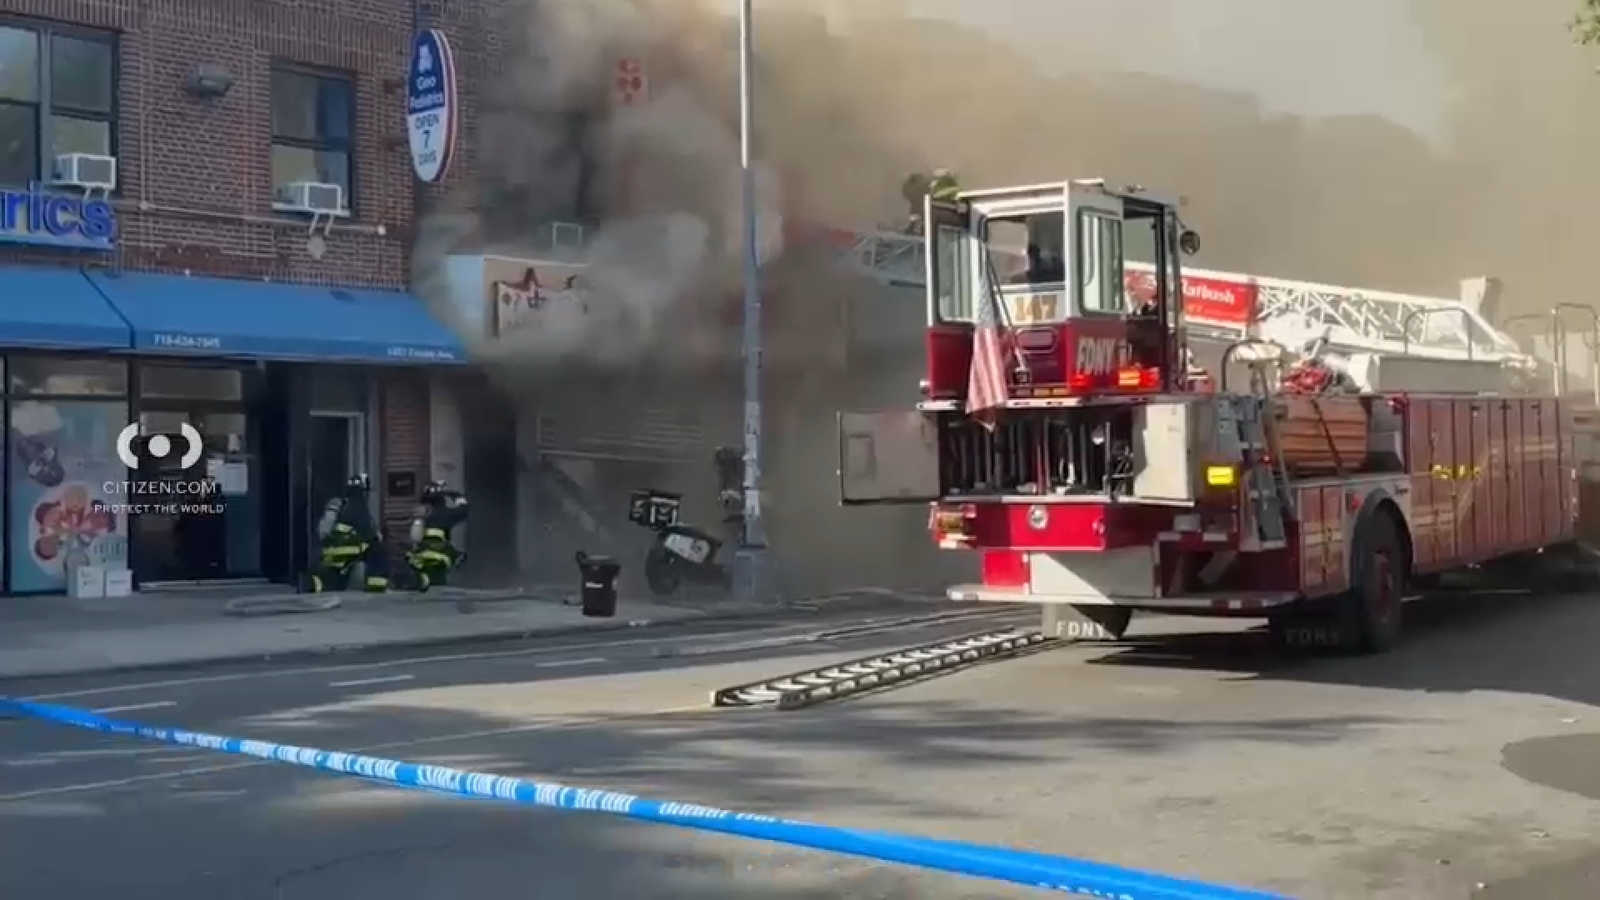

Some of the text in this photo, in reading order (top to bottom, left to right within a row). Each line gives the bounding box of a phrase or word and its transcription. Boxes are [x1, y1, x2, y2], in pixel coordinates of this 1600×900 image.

[415, 114, 439, 130] OPEN
[422, 130, 431, 149] 7
[1077, 336, 1116, 375] FDNY
[1056, 620, 1105, 637] FDNY
